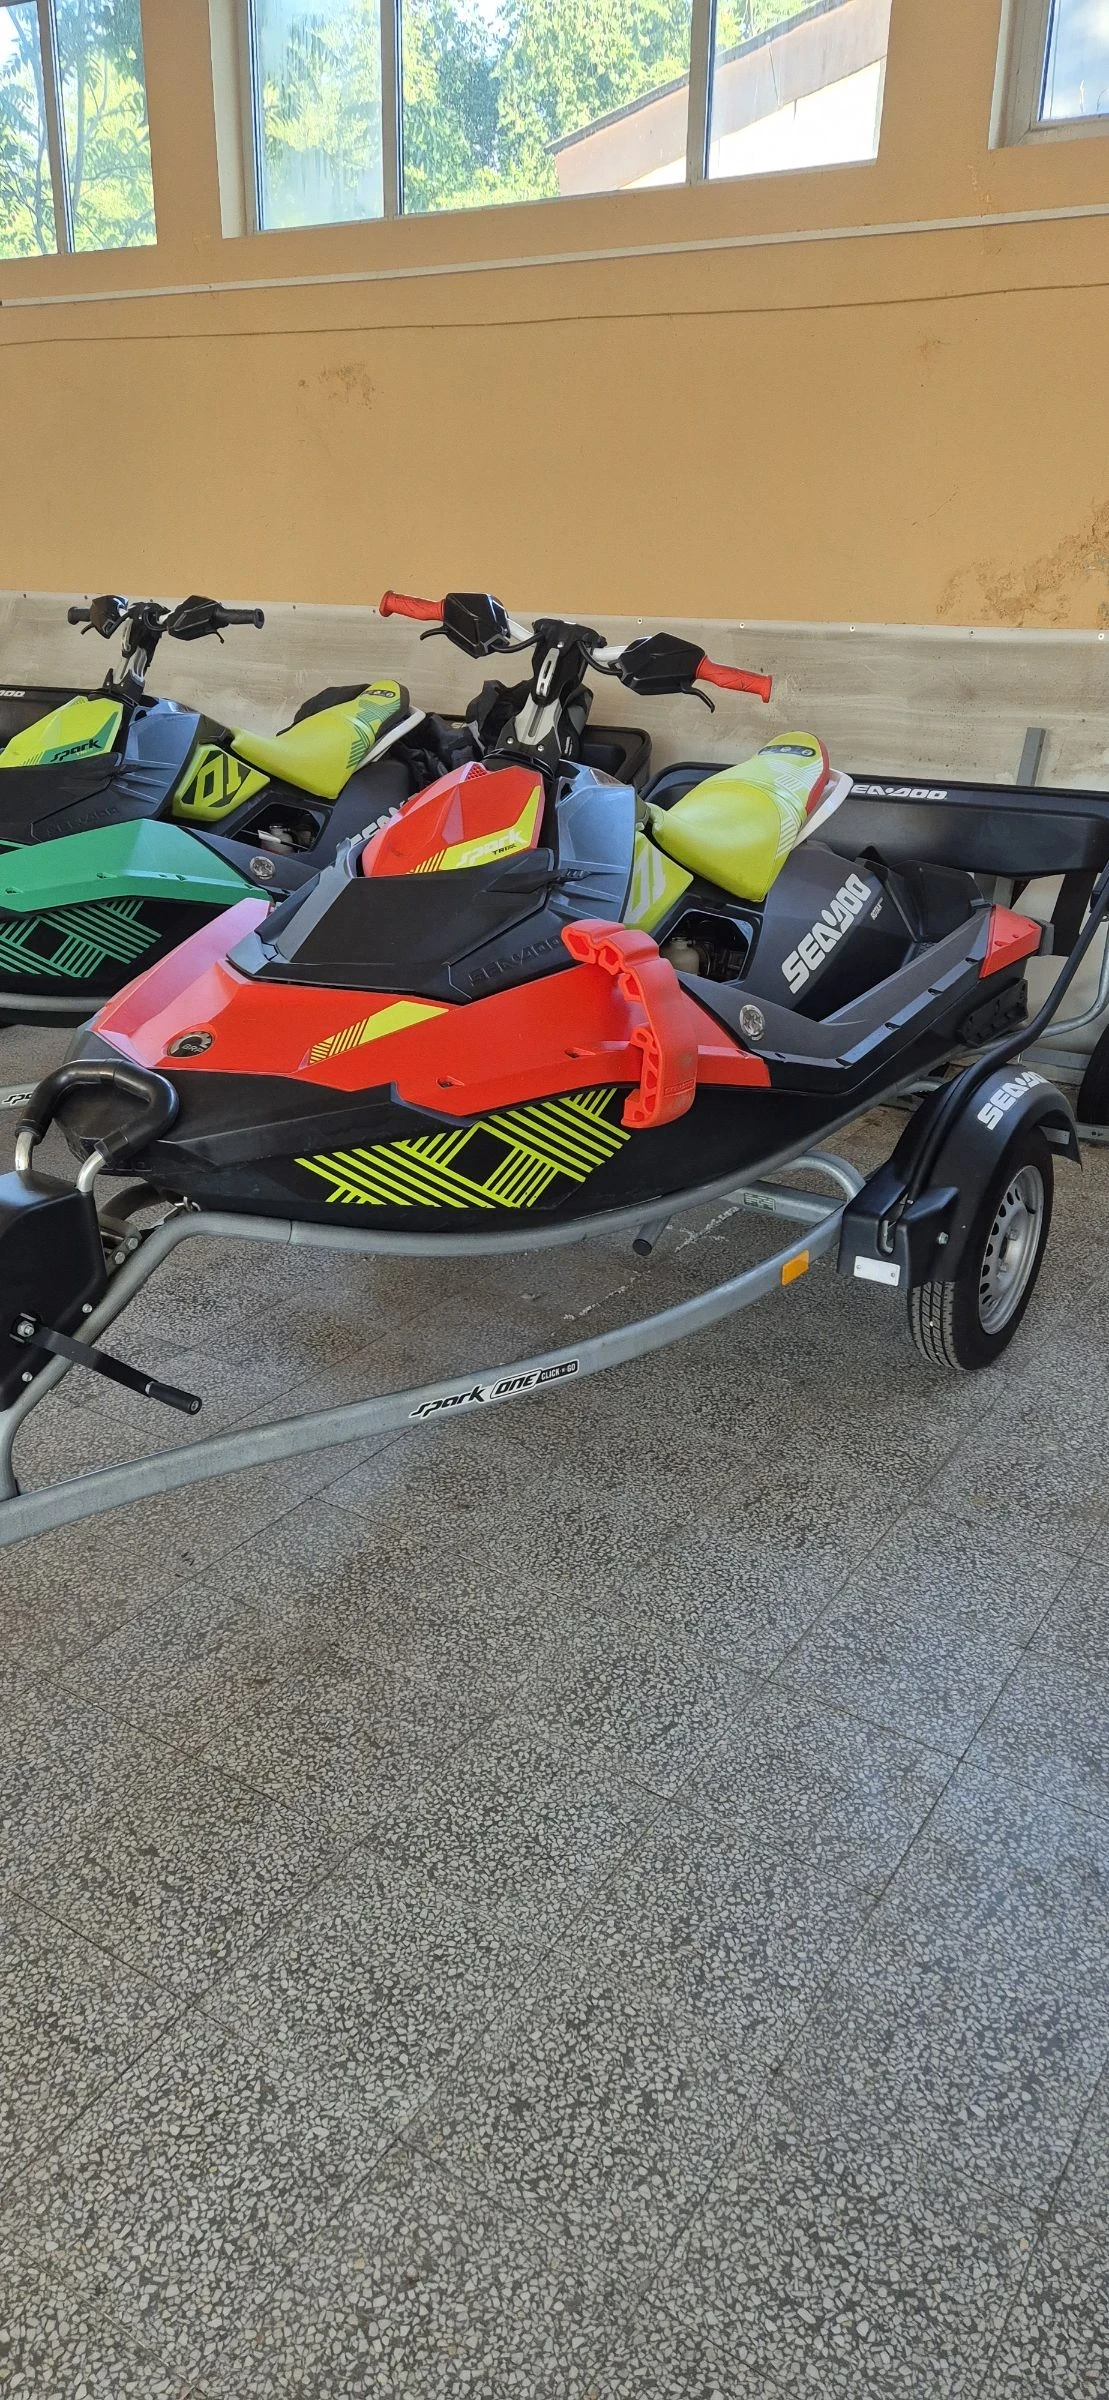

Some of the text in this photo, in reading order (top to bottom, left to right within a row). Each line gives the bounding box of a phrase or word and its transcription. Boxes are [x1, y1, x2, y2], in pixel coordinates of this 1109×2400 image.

[49, 738, 103, 762] spark
[411, 1385, 486, 1418] spark
[541, 1368, 561, 1380] CLICK
